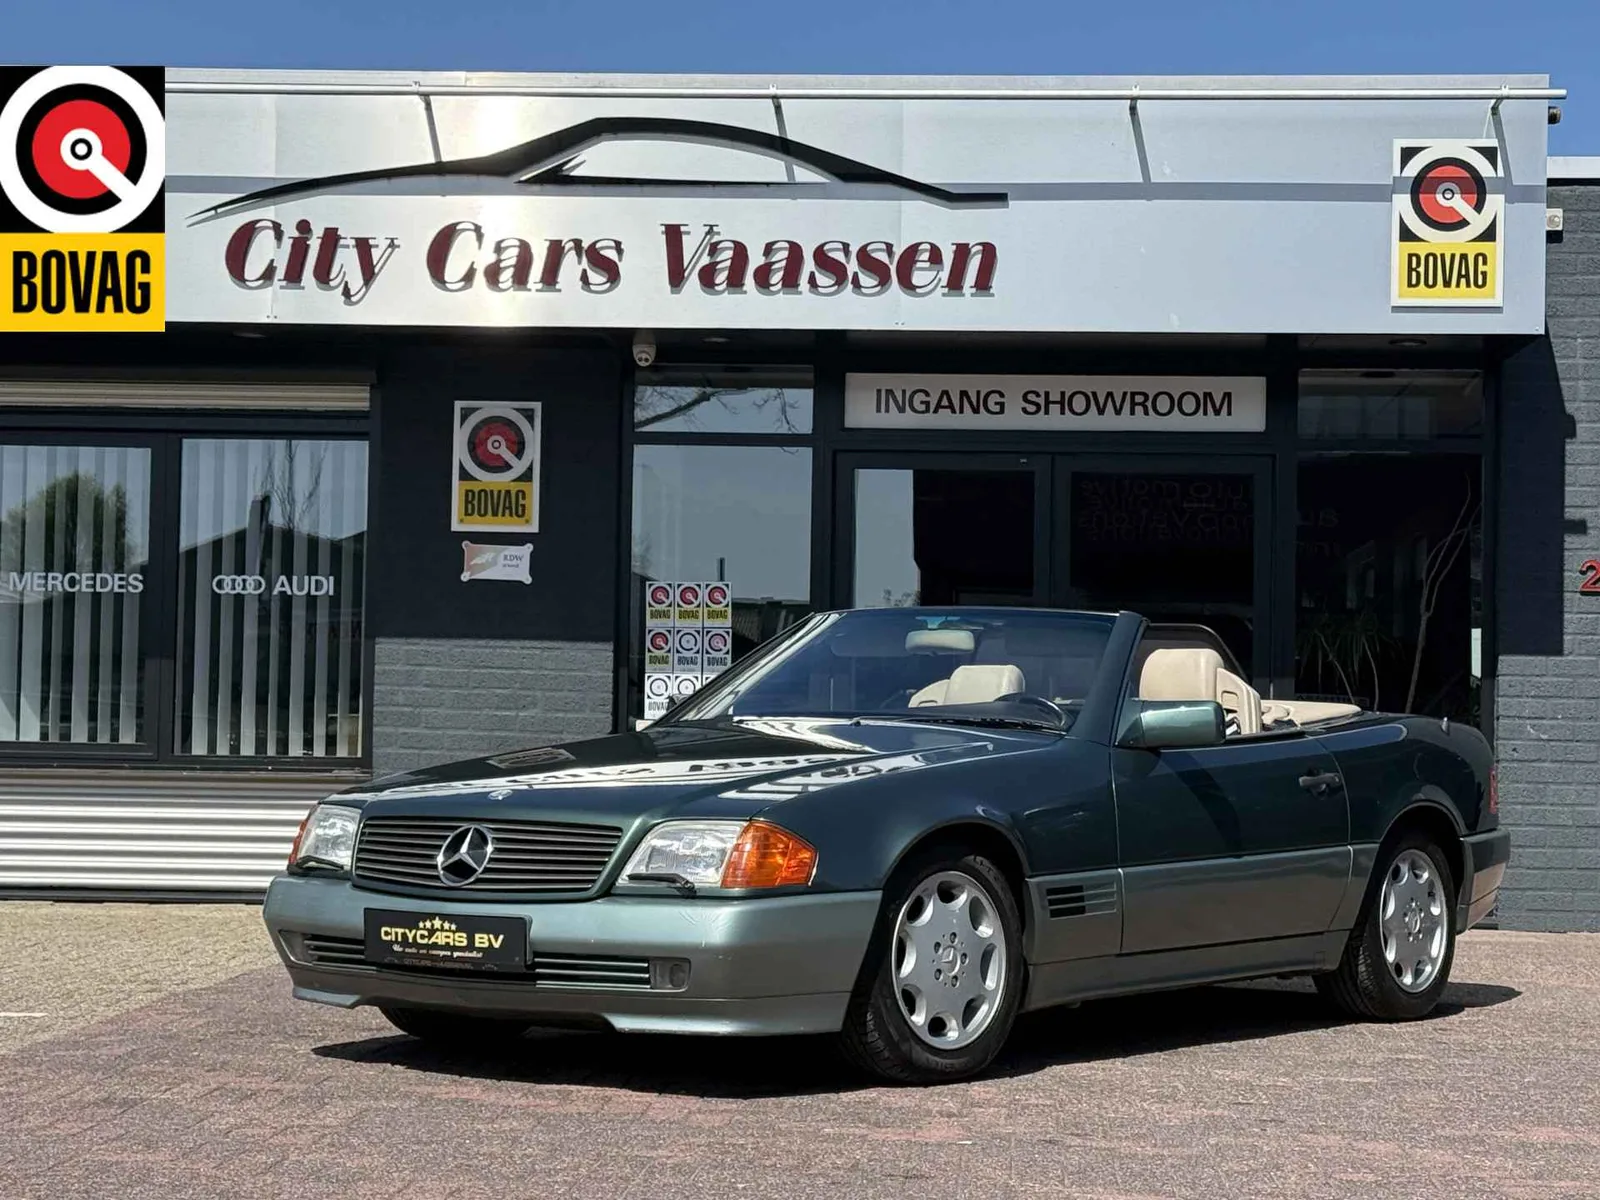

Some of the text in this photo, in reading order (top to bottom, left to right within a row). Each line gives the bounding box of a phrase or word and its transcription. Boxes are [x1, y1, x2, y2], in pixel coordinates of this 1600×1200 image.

[225, 218, 997, 303] City Cars Vaassen
[1407, 252, 1488, 289] BOVAG
[875, 388, 1233, 417] INGANG SHOWROOM
[464, 488, 527, 518] BOVAG
[503, 554, 524, 562] RDW
[9, 572, 144, 594] MERCEDES
[272, 575, 335, 596] AUDI
[650, 609, 671, 619] BOVAG
[678, 610, 699, 620] BOVAG
[707, 609, 728, 620] BOVAG
[649, 655, 669, 665] BOVAG
[677, 656, 698, 666] BOVAG
[707, 656, 728, 667] BOVAG
[380, 926, 504, 949] CITYCARS BV
